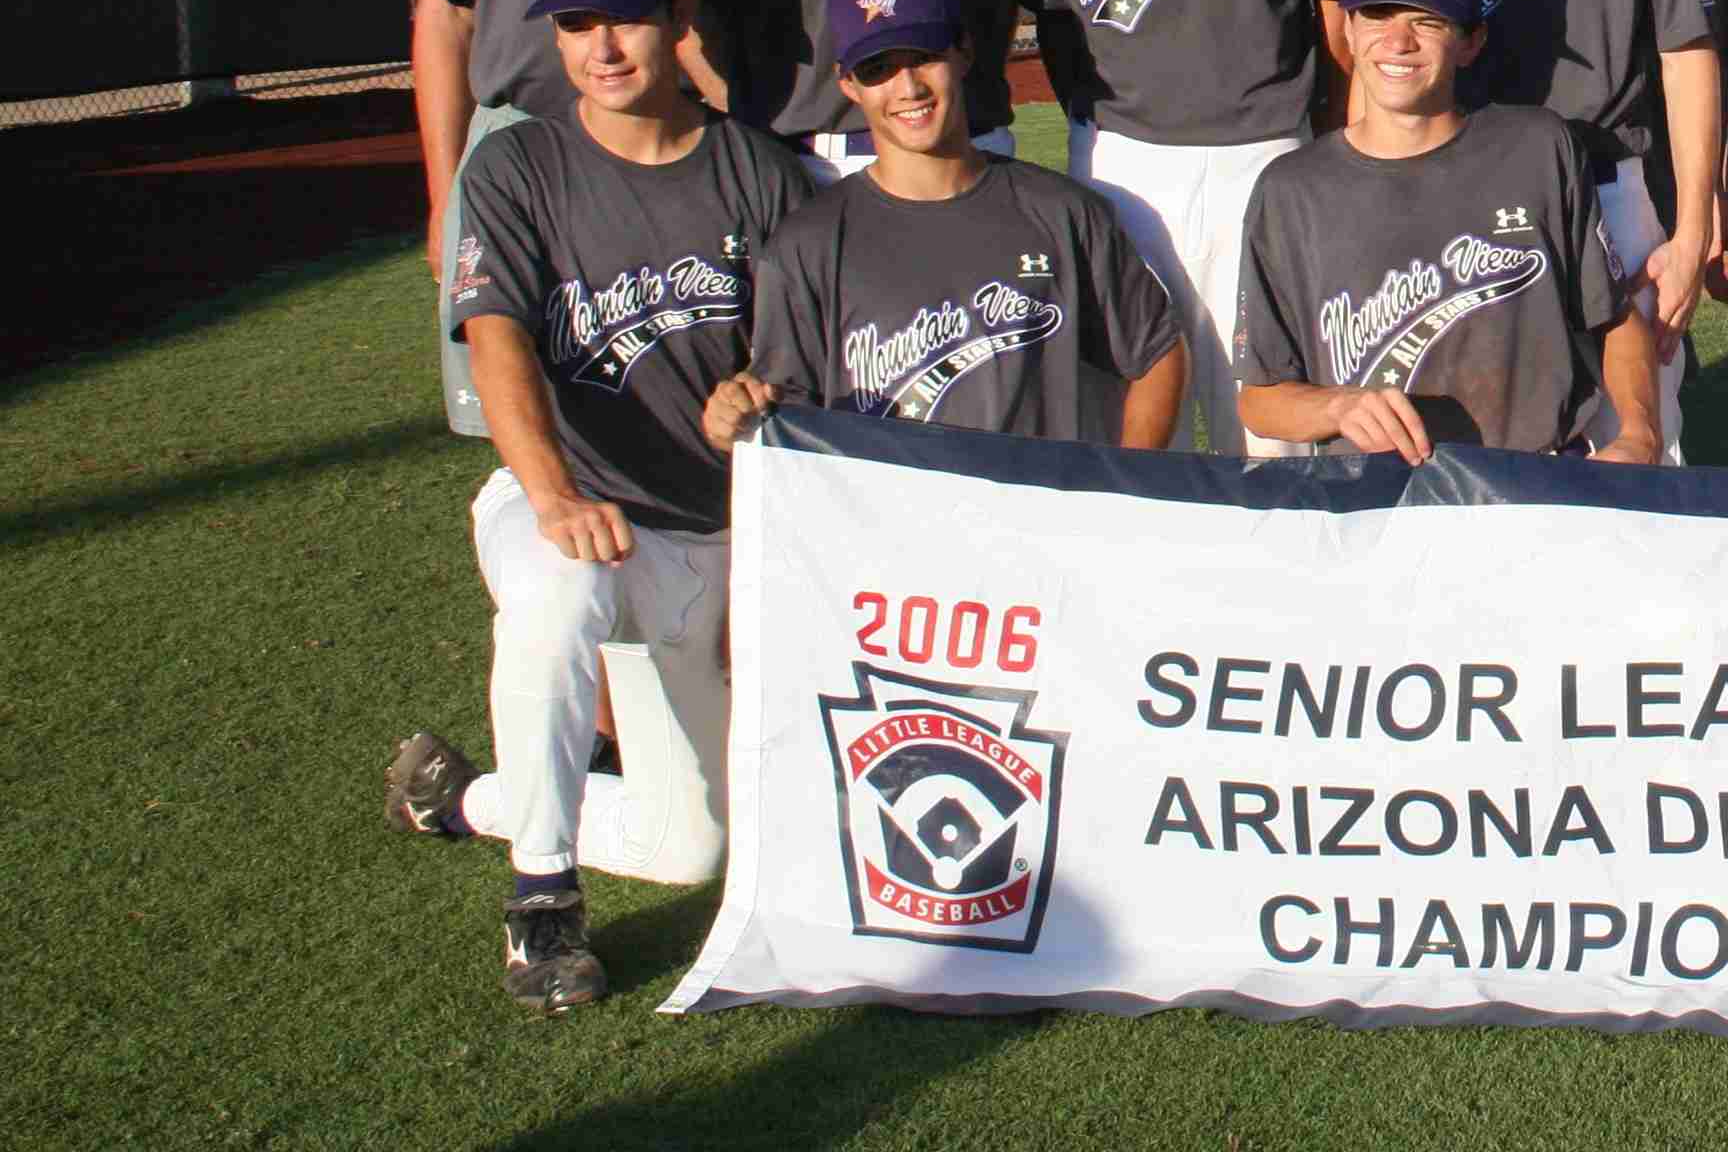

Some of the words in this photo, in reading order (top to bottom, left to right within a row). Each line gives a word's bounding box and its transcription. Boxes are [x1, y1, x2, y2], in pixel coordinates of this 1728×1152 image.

[611, 332, 645, 363] ALL
[846, 302, 968, 412] Mountain
[974, 282, 1044, 326] View
[1321, 261, 1440, 385] Mountain
[1443, 235, 1526, 282] View
[1391, 332, 1428, 369] ALL
[1424, 294, 1484, 330] STARS
[914, 369, 950, 403] ALL
[948, 337, 1006, 370] STARS
[853, 591, 1041, 673] 2006
[1137, 652, 1522, 742] SENIOR
[853, 718, 931, 763] LITTLE
[942, 719, 1036, 783] LEAGUE
[1144, 776, 1616, 858] ARIZONA
[879, 883, 1015, 922] BASEBALL
